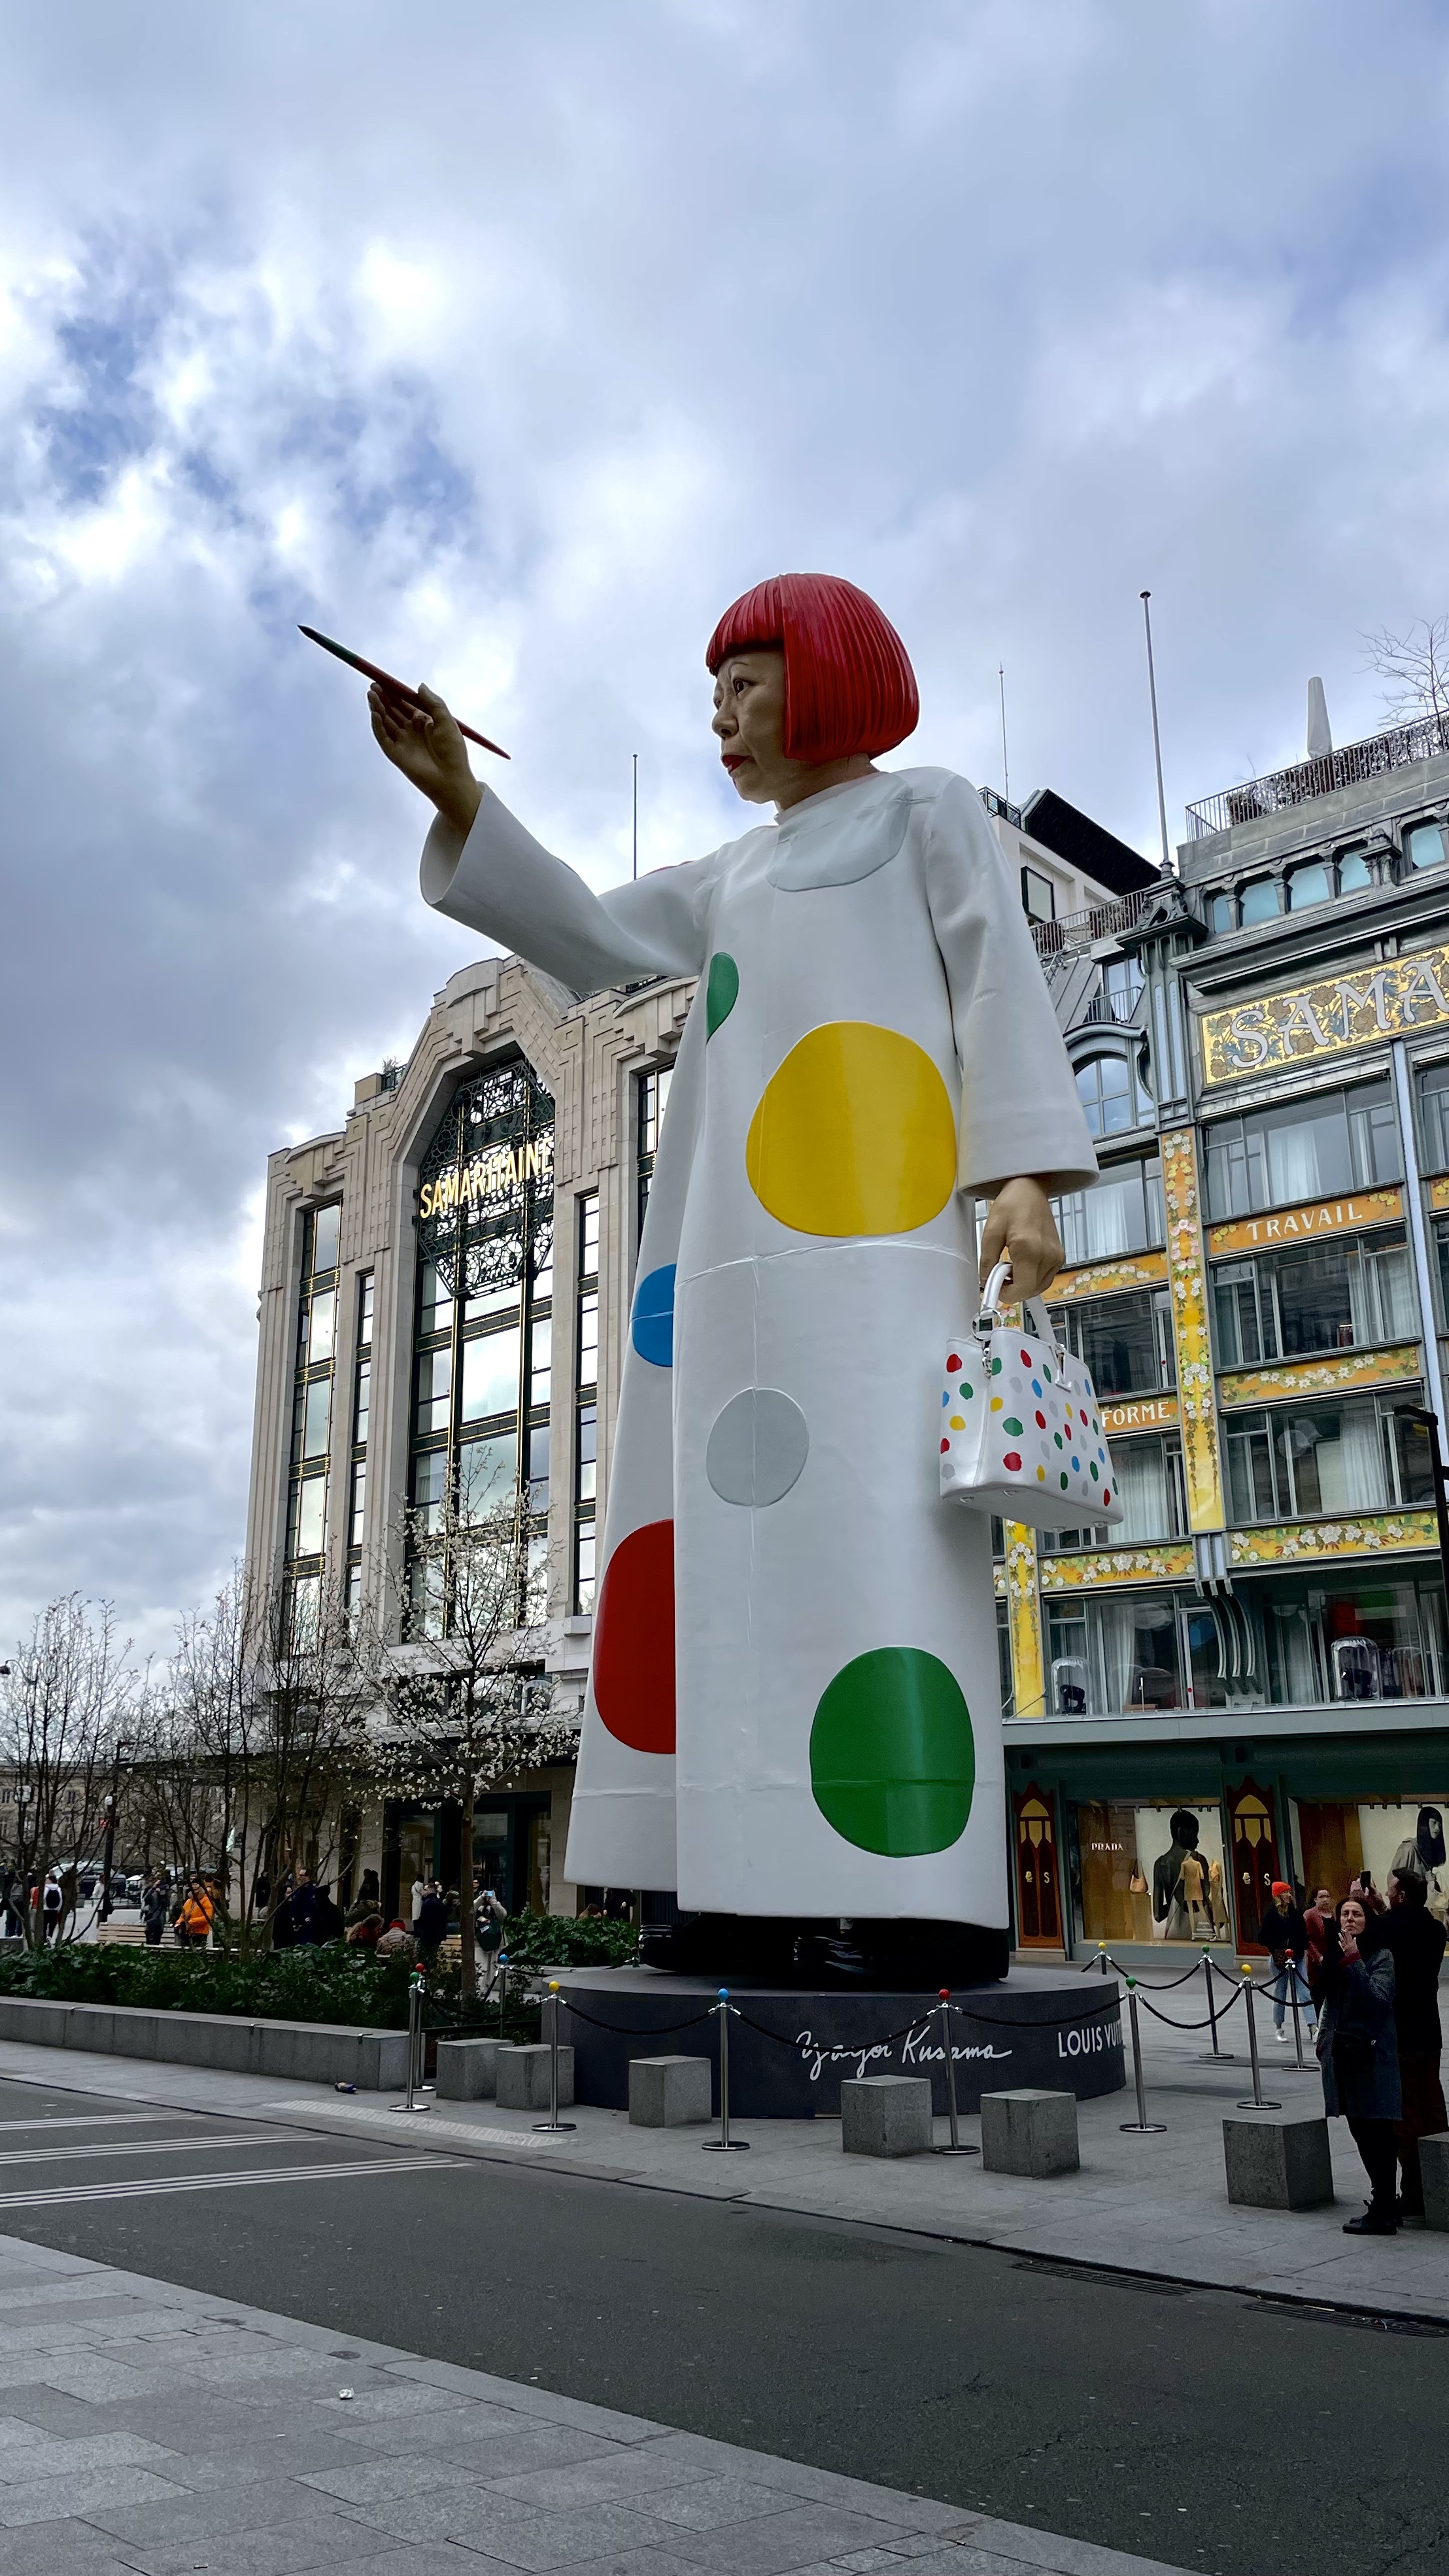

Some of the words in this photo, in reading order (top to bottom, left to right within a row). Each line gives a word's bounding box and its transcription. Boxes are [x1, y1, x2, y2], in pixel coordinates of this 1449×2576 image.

[1231, 956, 1449, 1068] SAMA
[420, 1135, 554, 1219] SAMARITAINE
[1246, 1202, 1363, 1241] TRAVAIL
[1091, 1842, 1124, 1852] PRADA
[1058, 2026, 1103, 2058] LOUIS
